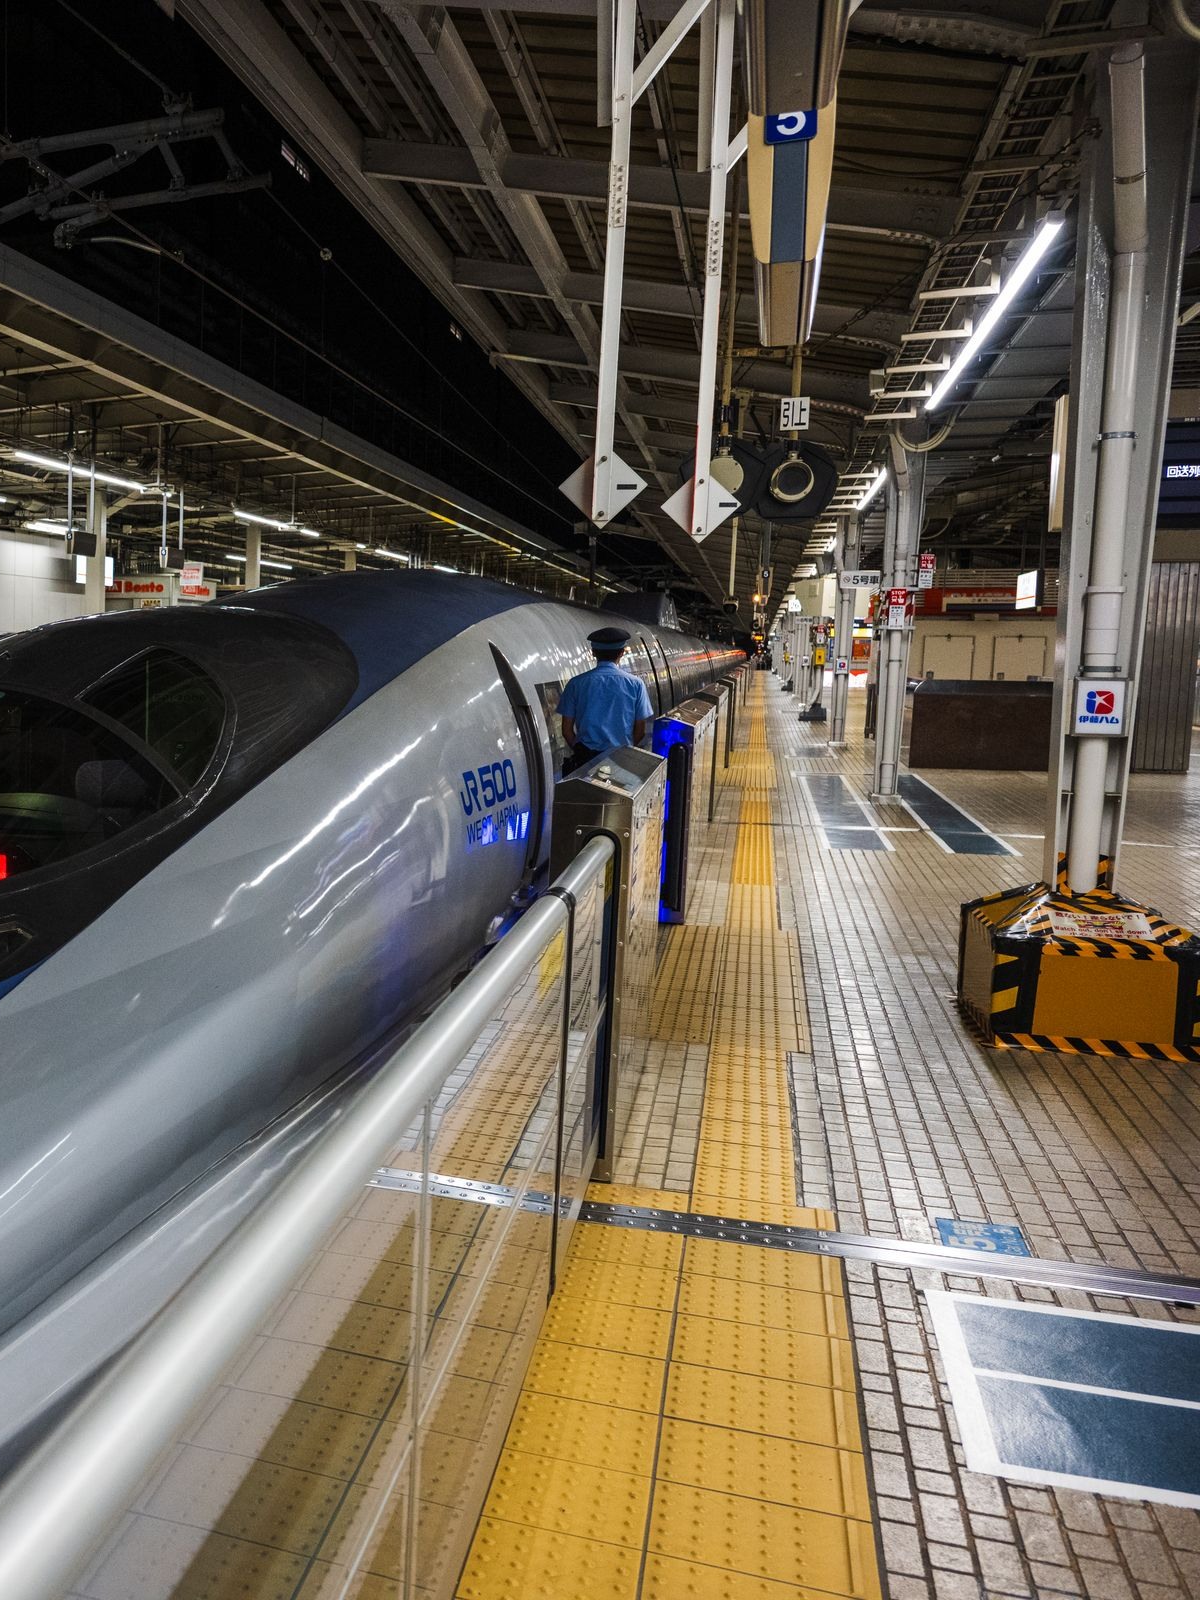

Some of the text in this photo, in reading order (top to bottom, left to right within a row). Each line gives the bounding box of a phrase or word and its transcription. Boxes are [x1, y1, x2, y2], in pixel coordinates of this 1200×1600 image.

[782, 400, 807, 428] 引上
[1166, 465, 1200, 478] 回送列
[852, 575, 880, 585] 5号車
[1078, 715, 1120, 724] 伊藤ハム
[477, 758, 517, 809] 500
[466, 803, 520, 845] WEST JAPAN
